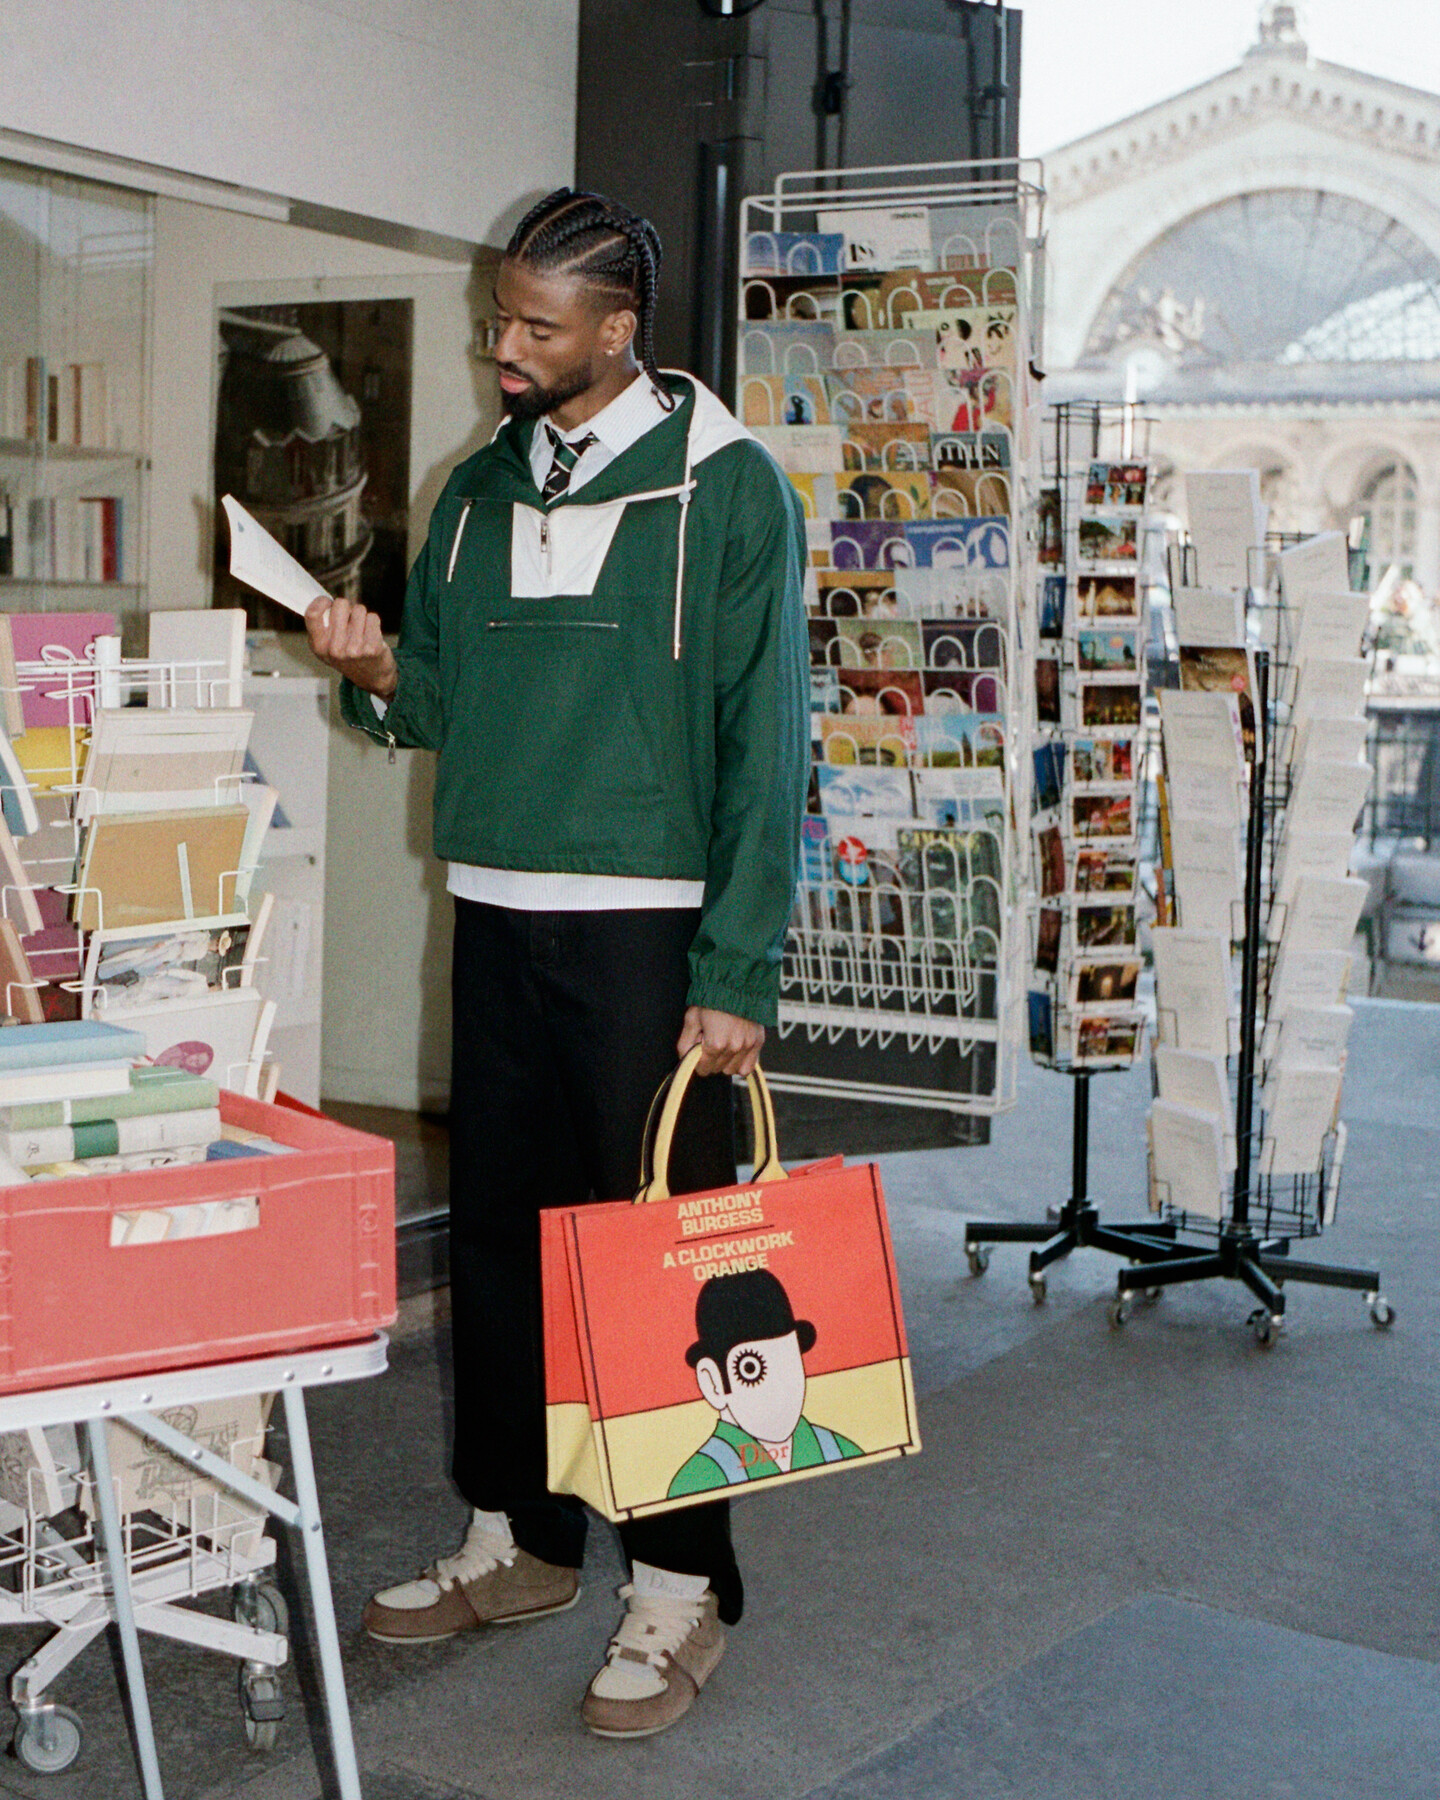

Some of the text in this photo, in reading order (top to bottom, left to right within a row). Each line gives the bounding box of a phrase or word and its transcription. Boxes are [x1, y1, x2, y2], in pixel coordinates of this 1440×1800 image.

[678, 1190, 763, 1220] ANTHONY
[682, 1208, 764, 1236] BURGESS
[663, 1231, 794, 1269] A CLOCKWORK
[693, 1254, 770, 1281] ORANGE
[737, 1443, 789, 1468] Dior
[649, 1572, 686, 1596] Dior
